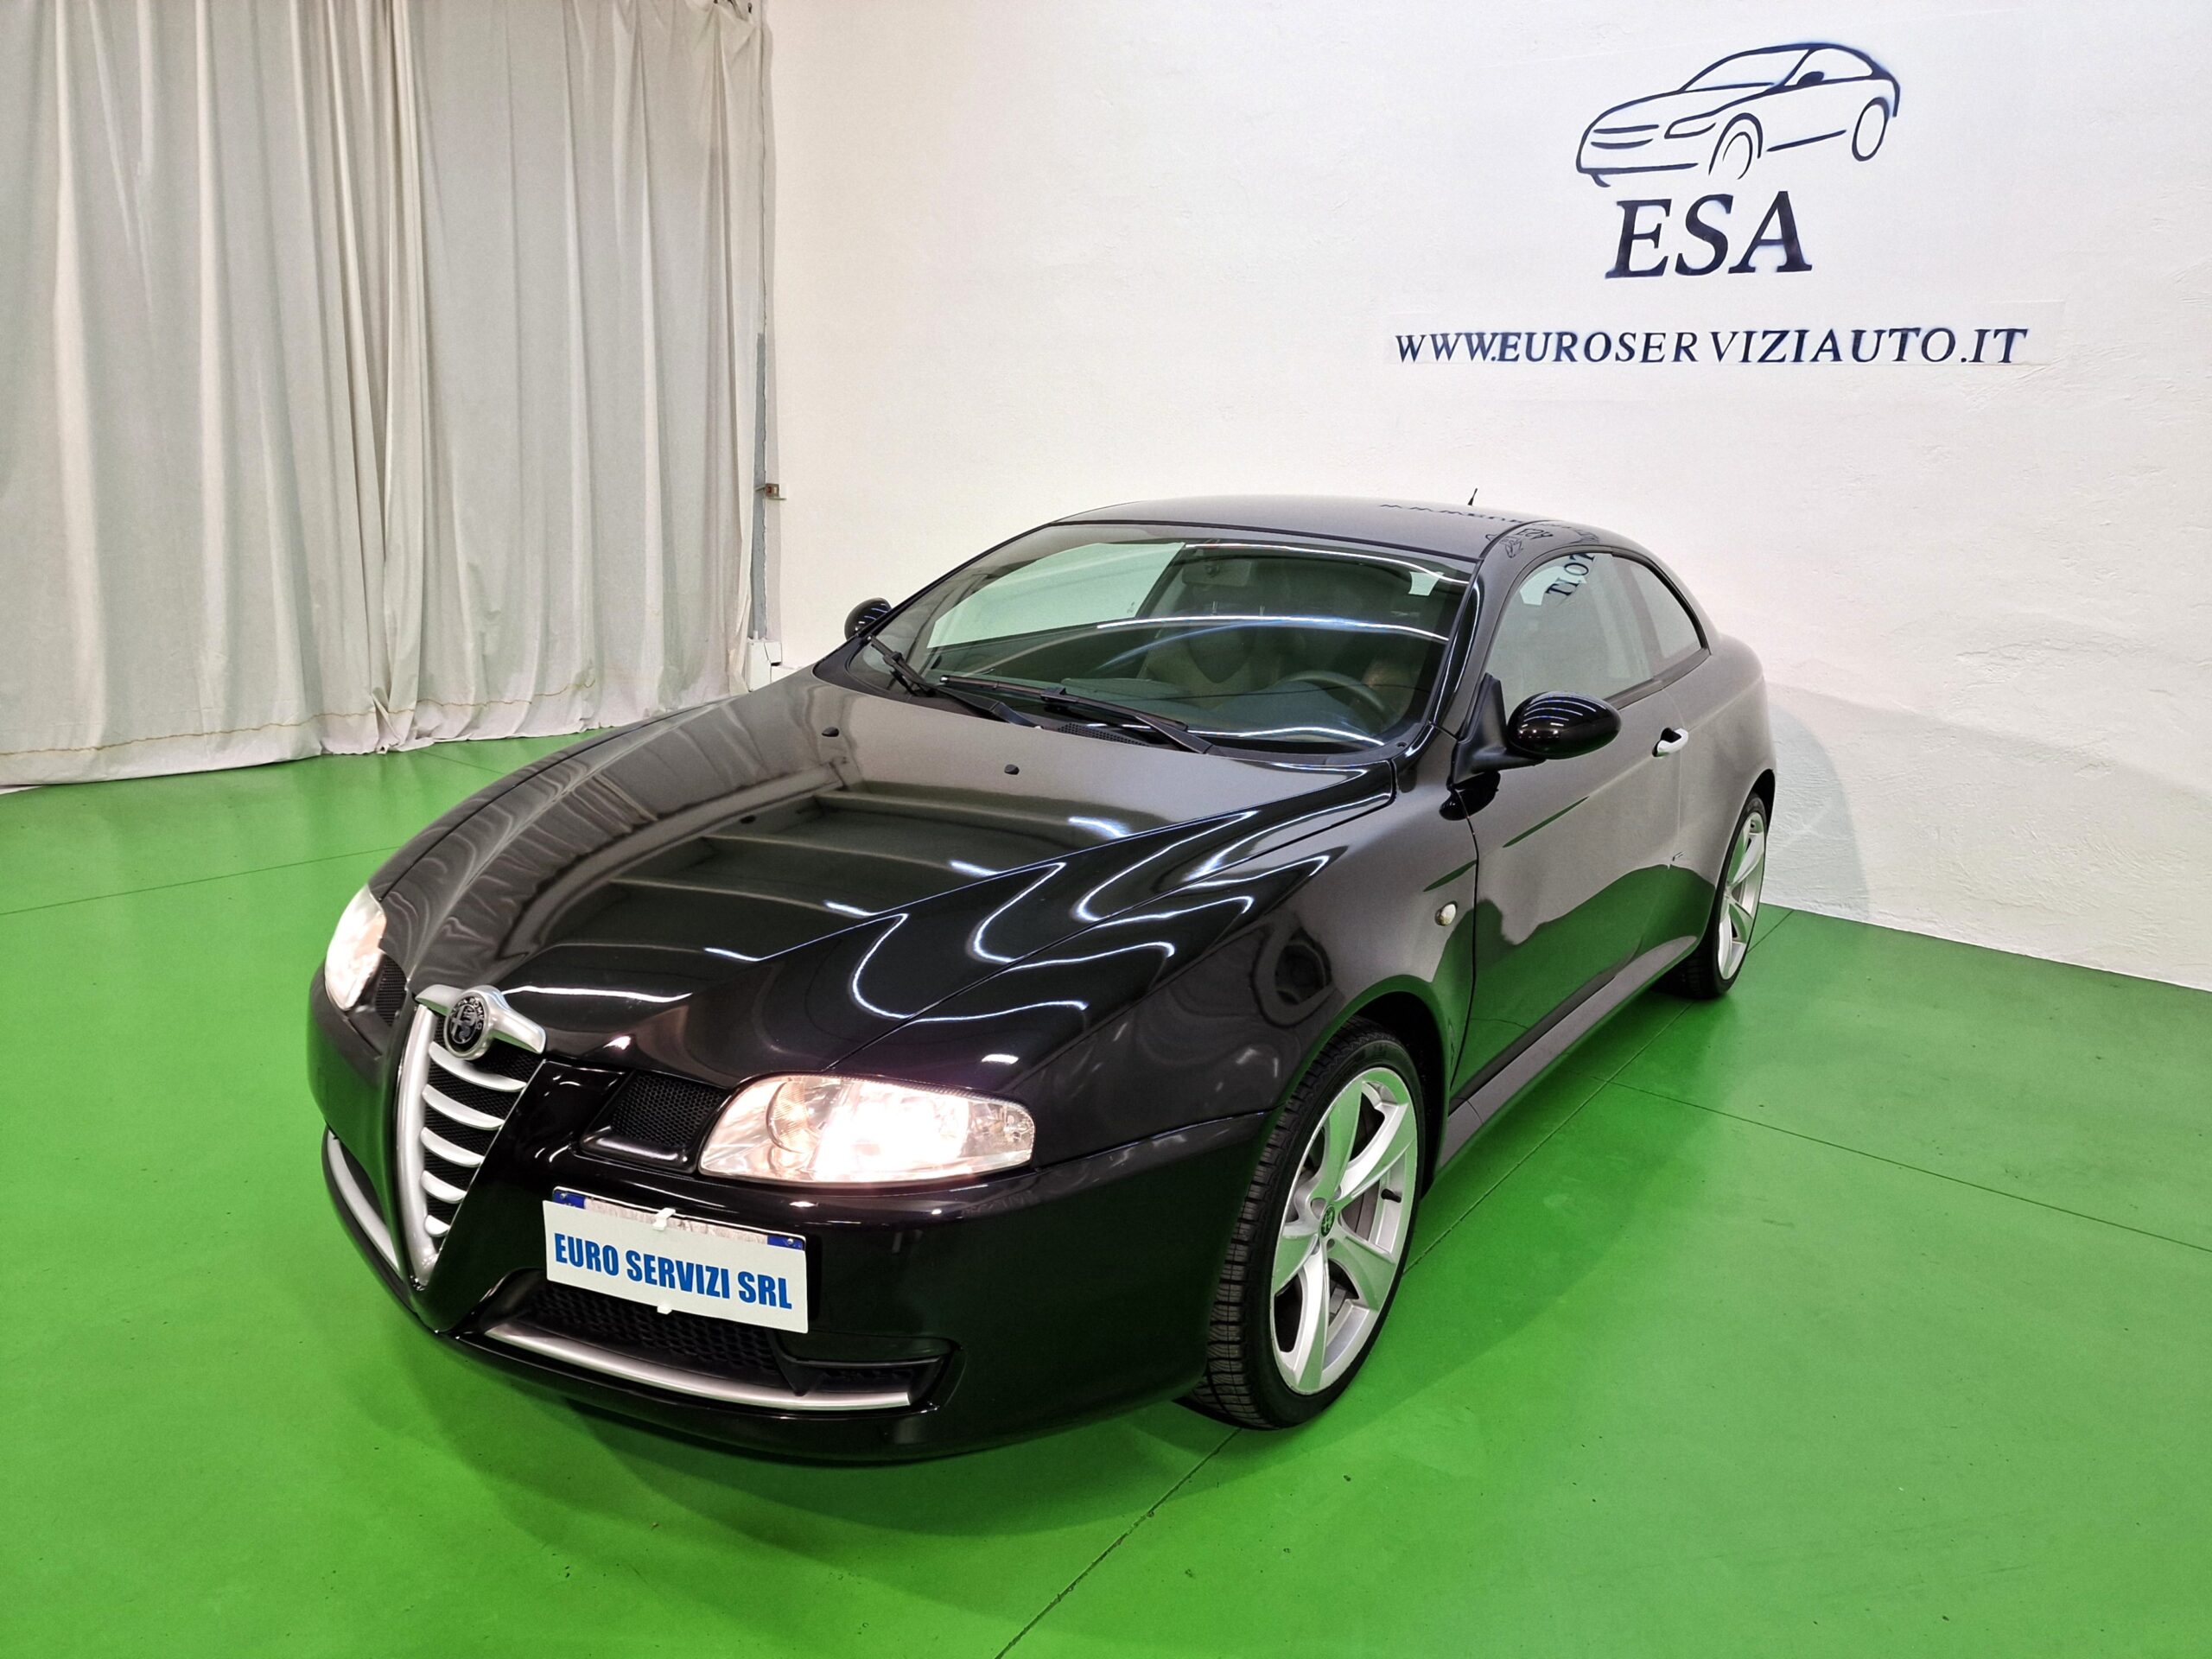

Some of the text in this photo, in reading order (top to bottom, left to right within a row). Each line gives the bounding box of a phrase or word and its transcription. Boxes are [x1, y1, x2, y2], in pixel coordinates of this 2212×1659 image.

[1605, 190, 1813, 279] ESA
[554, 1233, 793, 1311] EURO SERVIZI SRL
